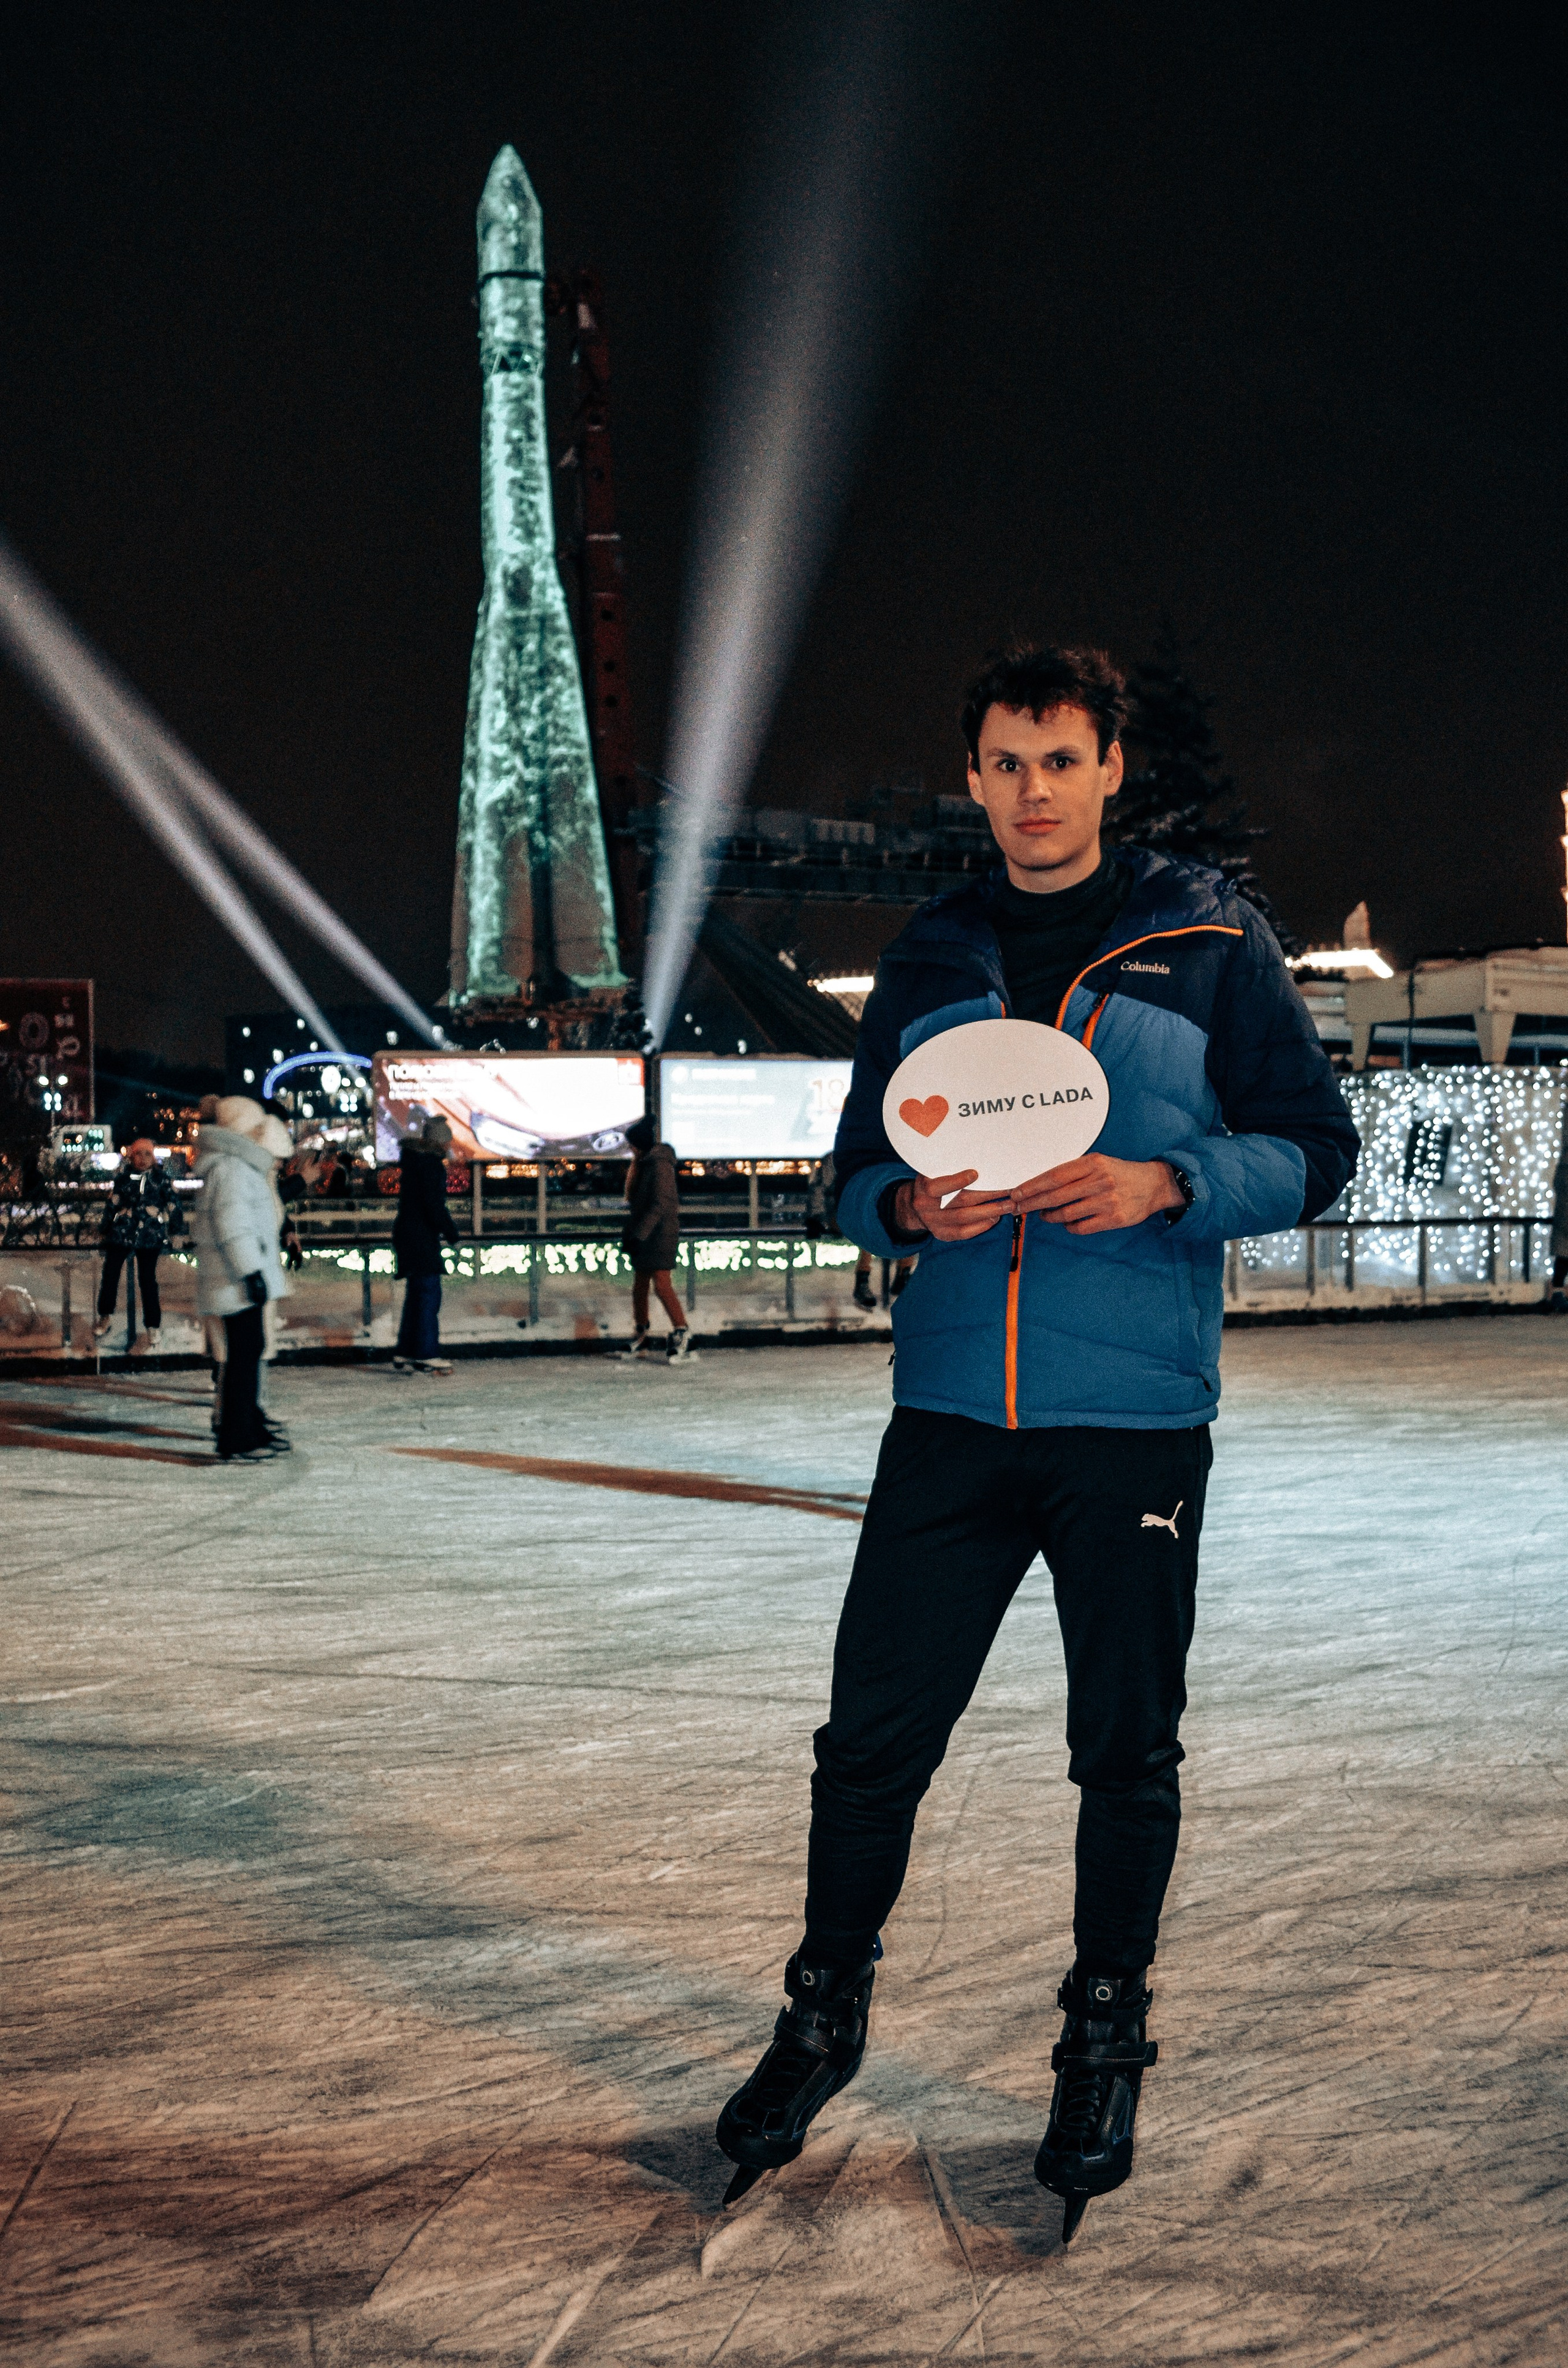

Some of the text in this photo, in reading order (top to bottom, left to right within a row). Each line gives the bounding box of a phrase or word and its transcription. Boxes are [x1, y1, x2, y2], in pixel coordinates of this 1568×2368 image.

[1120, 961, 1170, 975] Columbia
[958, 1087, 1093, 1118] ЗИМУ С LADA
